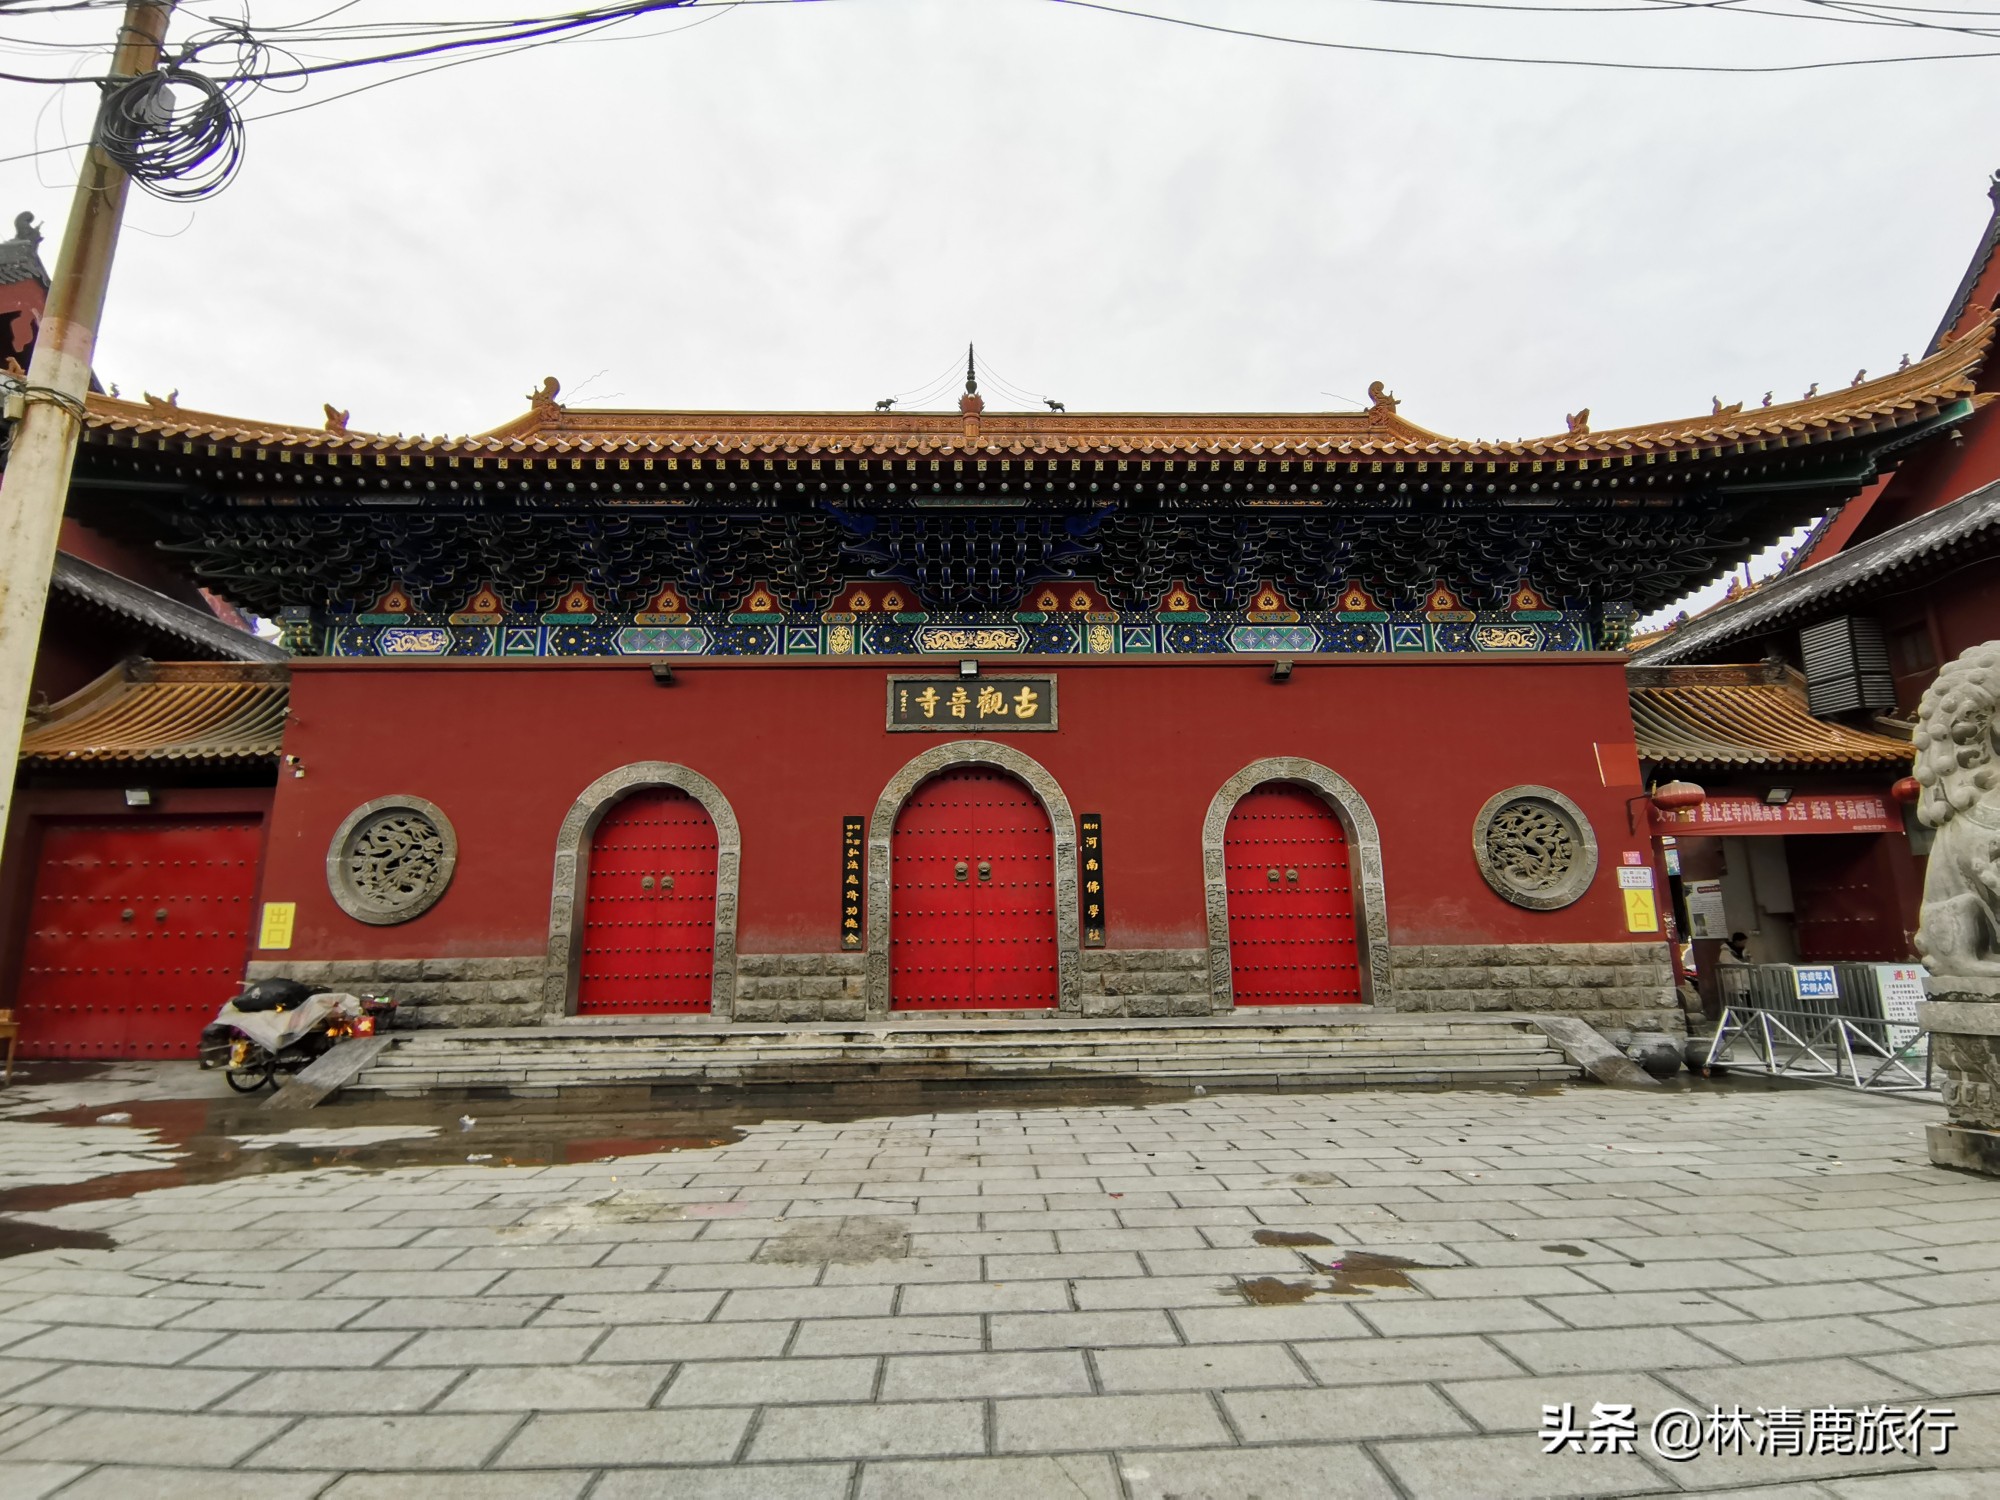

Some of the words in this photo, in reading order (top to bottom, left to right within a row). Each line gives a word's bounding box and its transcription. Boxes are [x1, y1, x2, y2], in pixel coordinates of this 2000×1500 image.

[1655, 807, 1697, 823] 文明香
[1631, 892, 1651, 929] 入口
[266, 908, 287, 945] 出口
[1799, 971, 1831, 982] 未成年人
[1893, 969, 1917, 981] 通知
[1801, 983, 1833, 993] 不得入内
